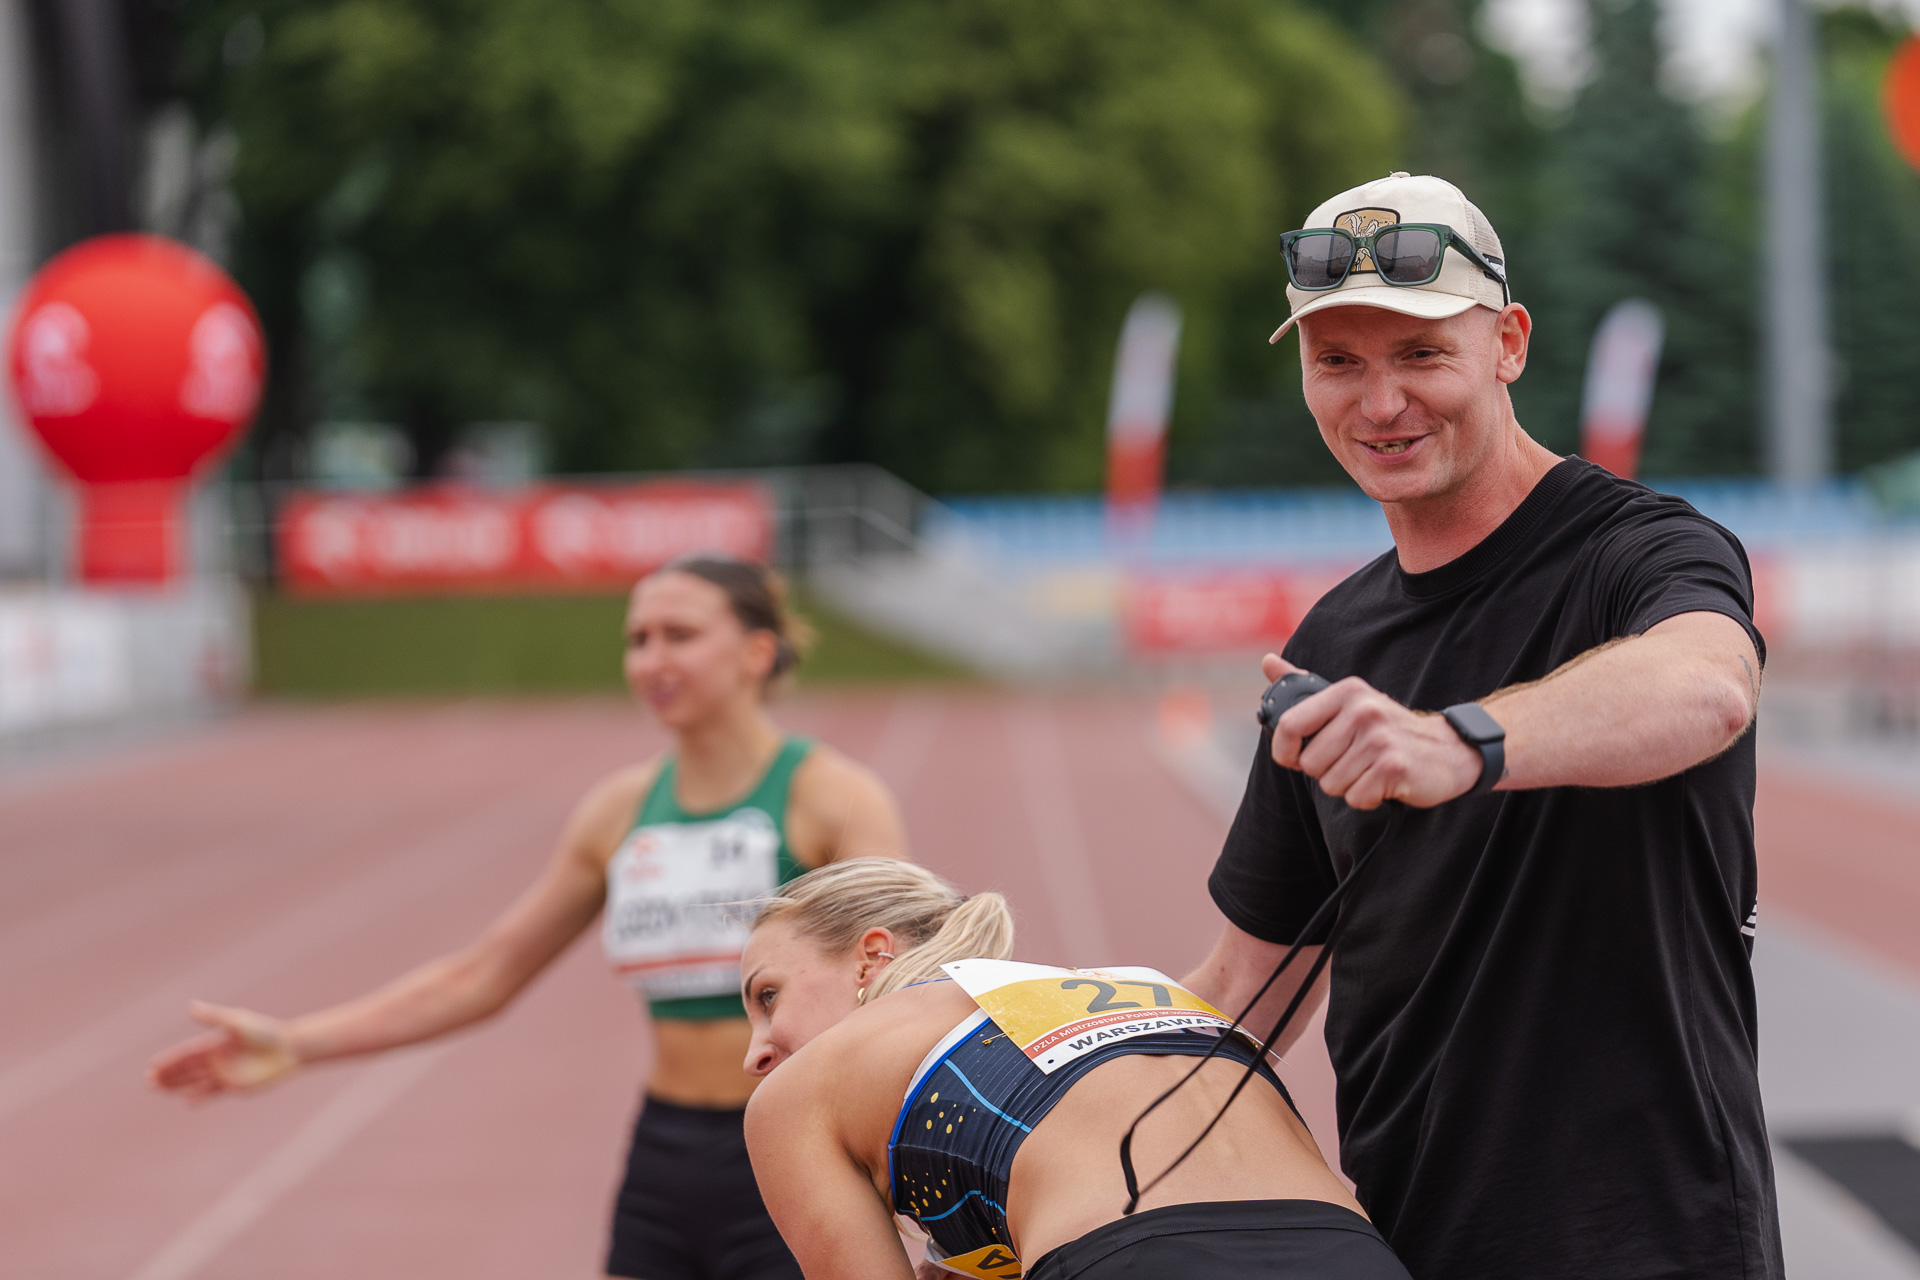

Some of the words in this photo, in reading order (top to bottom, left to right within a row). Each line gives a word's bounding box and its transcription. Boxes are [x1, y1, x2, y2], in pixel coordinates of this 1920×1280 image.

[1060, 978, 1173, 1014] 27
[1032, 1036, 1060, 1053] PZLA
[1059, 1015, 1125, 1038] Mistrzostwa
[1125, 1010, 1159, 1020] Polski
[1068, 1018, 1212, 1052] WARSZAWA
